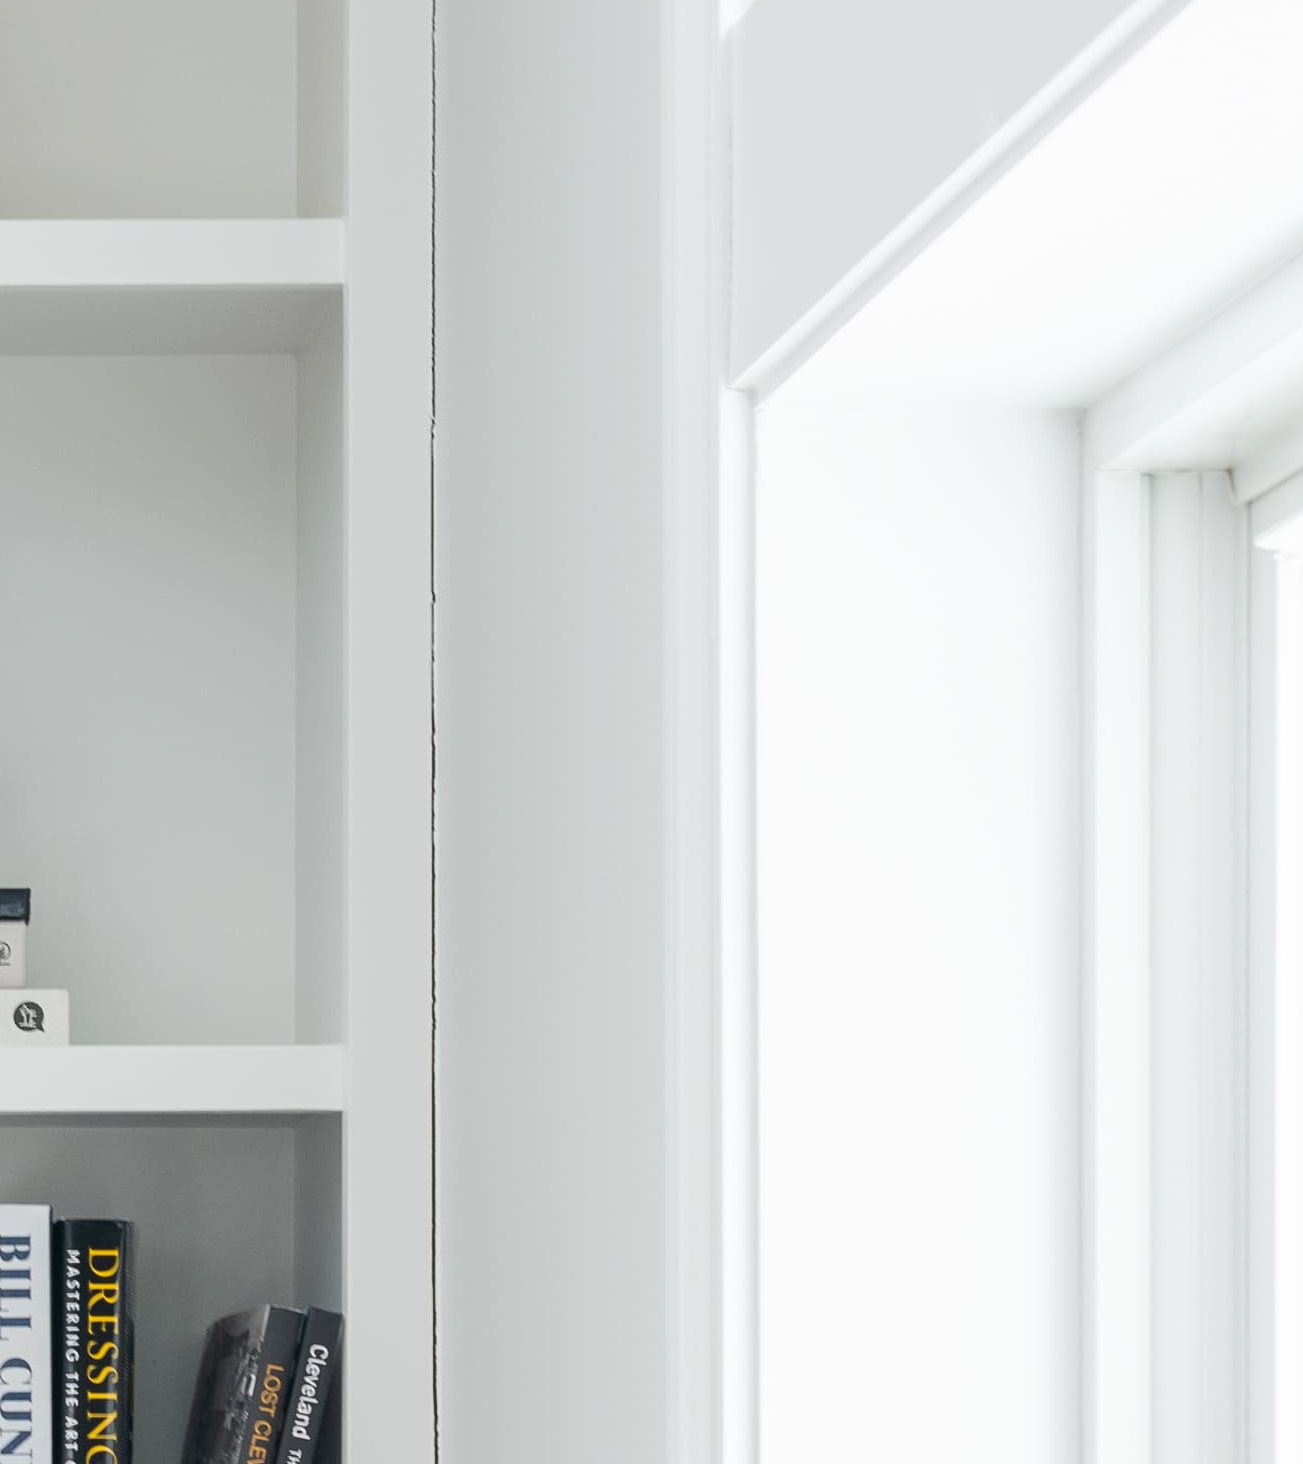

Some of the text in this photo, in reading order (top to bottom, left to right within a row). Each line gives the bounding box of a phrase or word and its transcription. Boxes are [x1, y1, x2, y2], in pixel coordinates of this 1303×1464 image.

[65, 1248, 81, 1363] MASTERING
[65, 1371, 79, 1407] THE
[258, 1363, 285, 1419] LOST
[291, 1343, 330, 1441] Cleveland
[64, 1416, 79, 1451] ART
